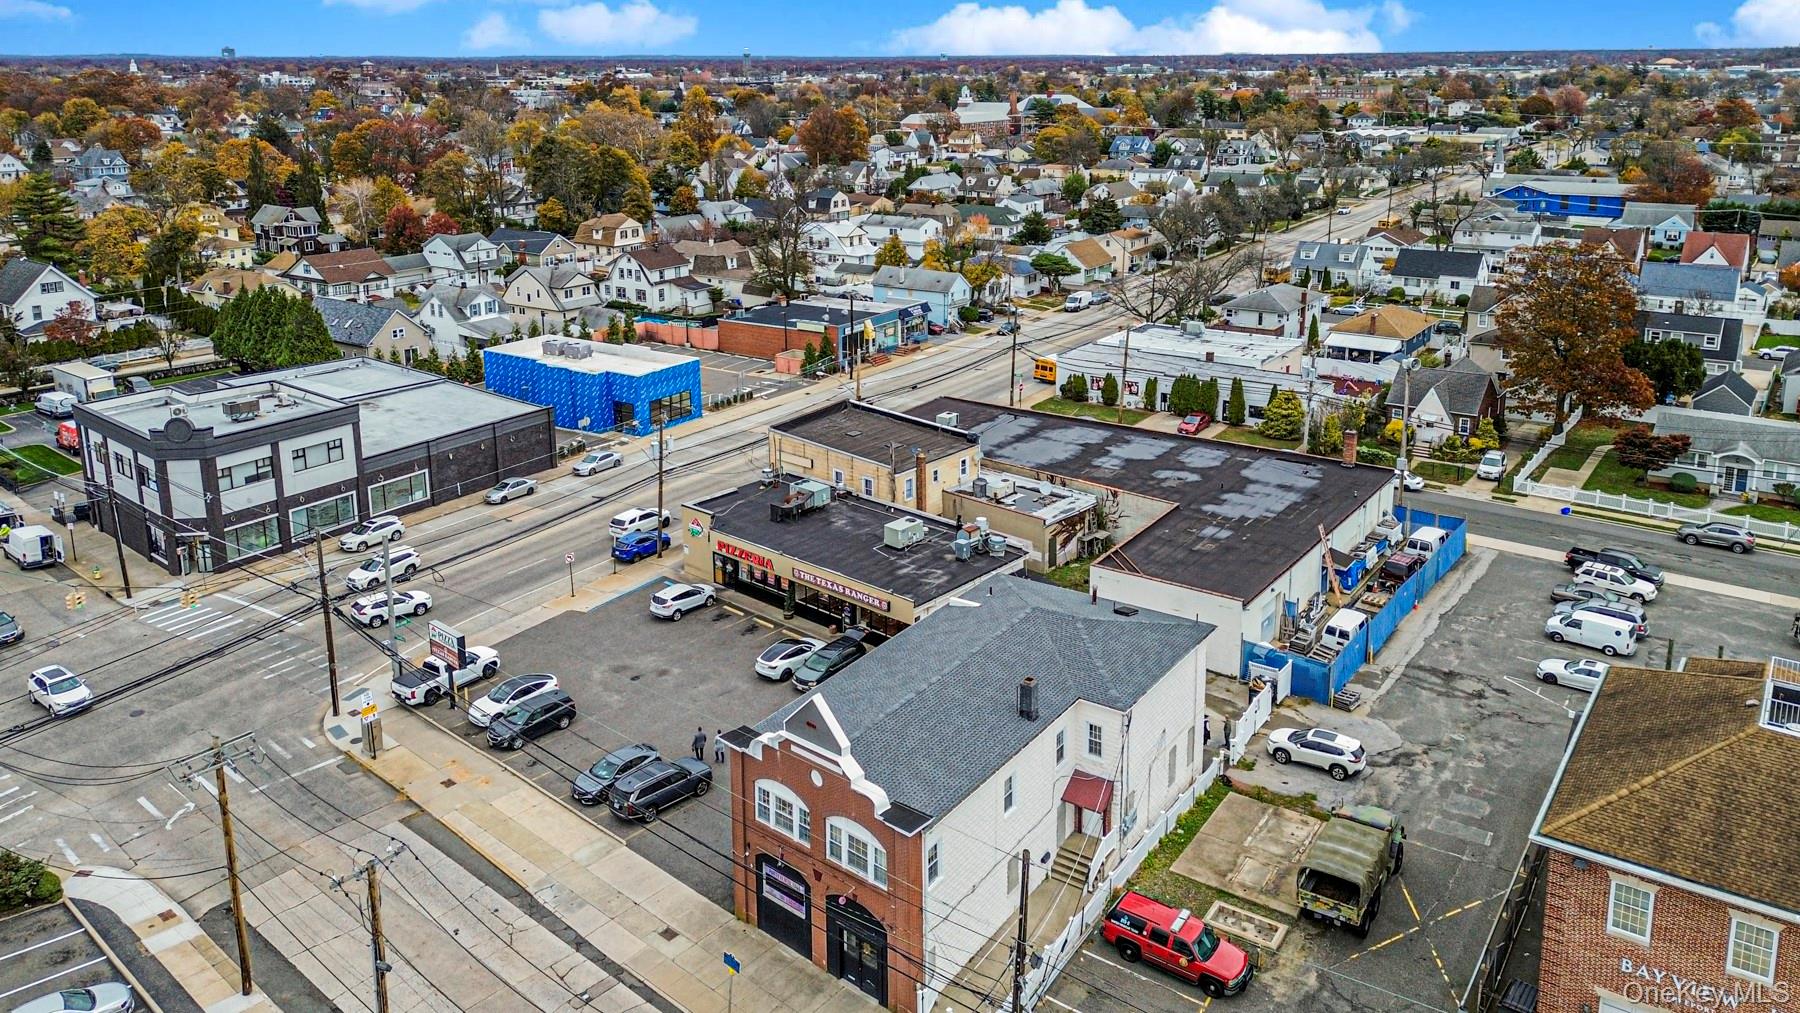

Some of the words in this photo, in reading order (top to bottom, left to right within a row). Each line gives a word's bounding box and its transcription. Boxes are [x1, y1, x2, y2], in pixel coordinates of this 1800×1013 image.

[716, 540, 775, 571] PIZZERIA
[799, 571, 816, 583] THE
[816, 577, 844, 593] TEXAS
[845, 587, 880, 607] RANGER
[437, 631, 456, 648] PIZZA
